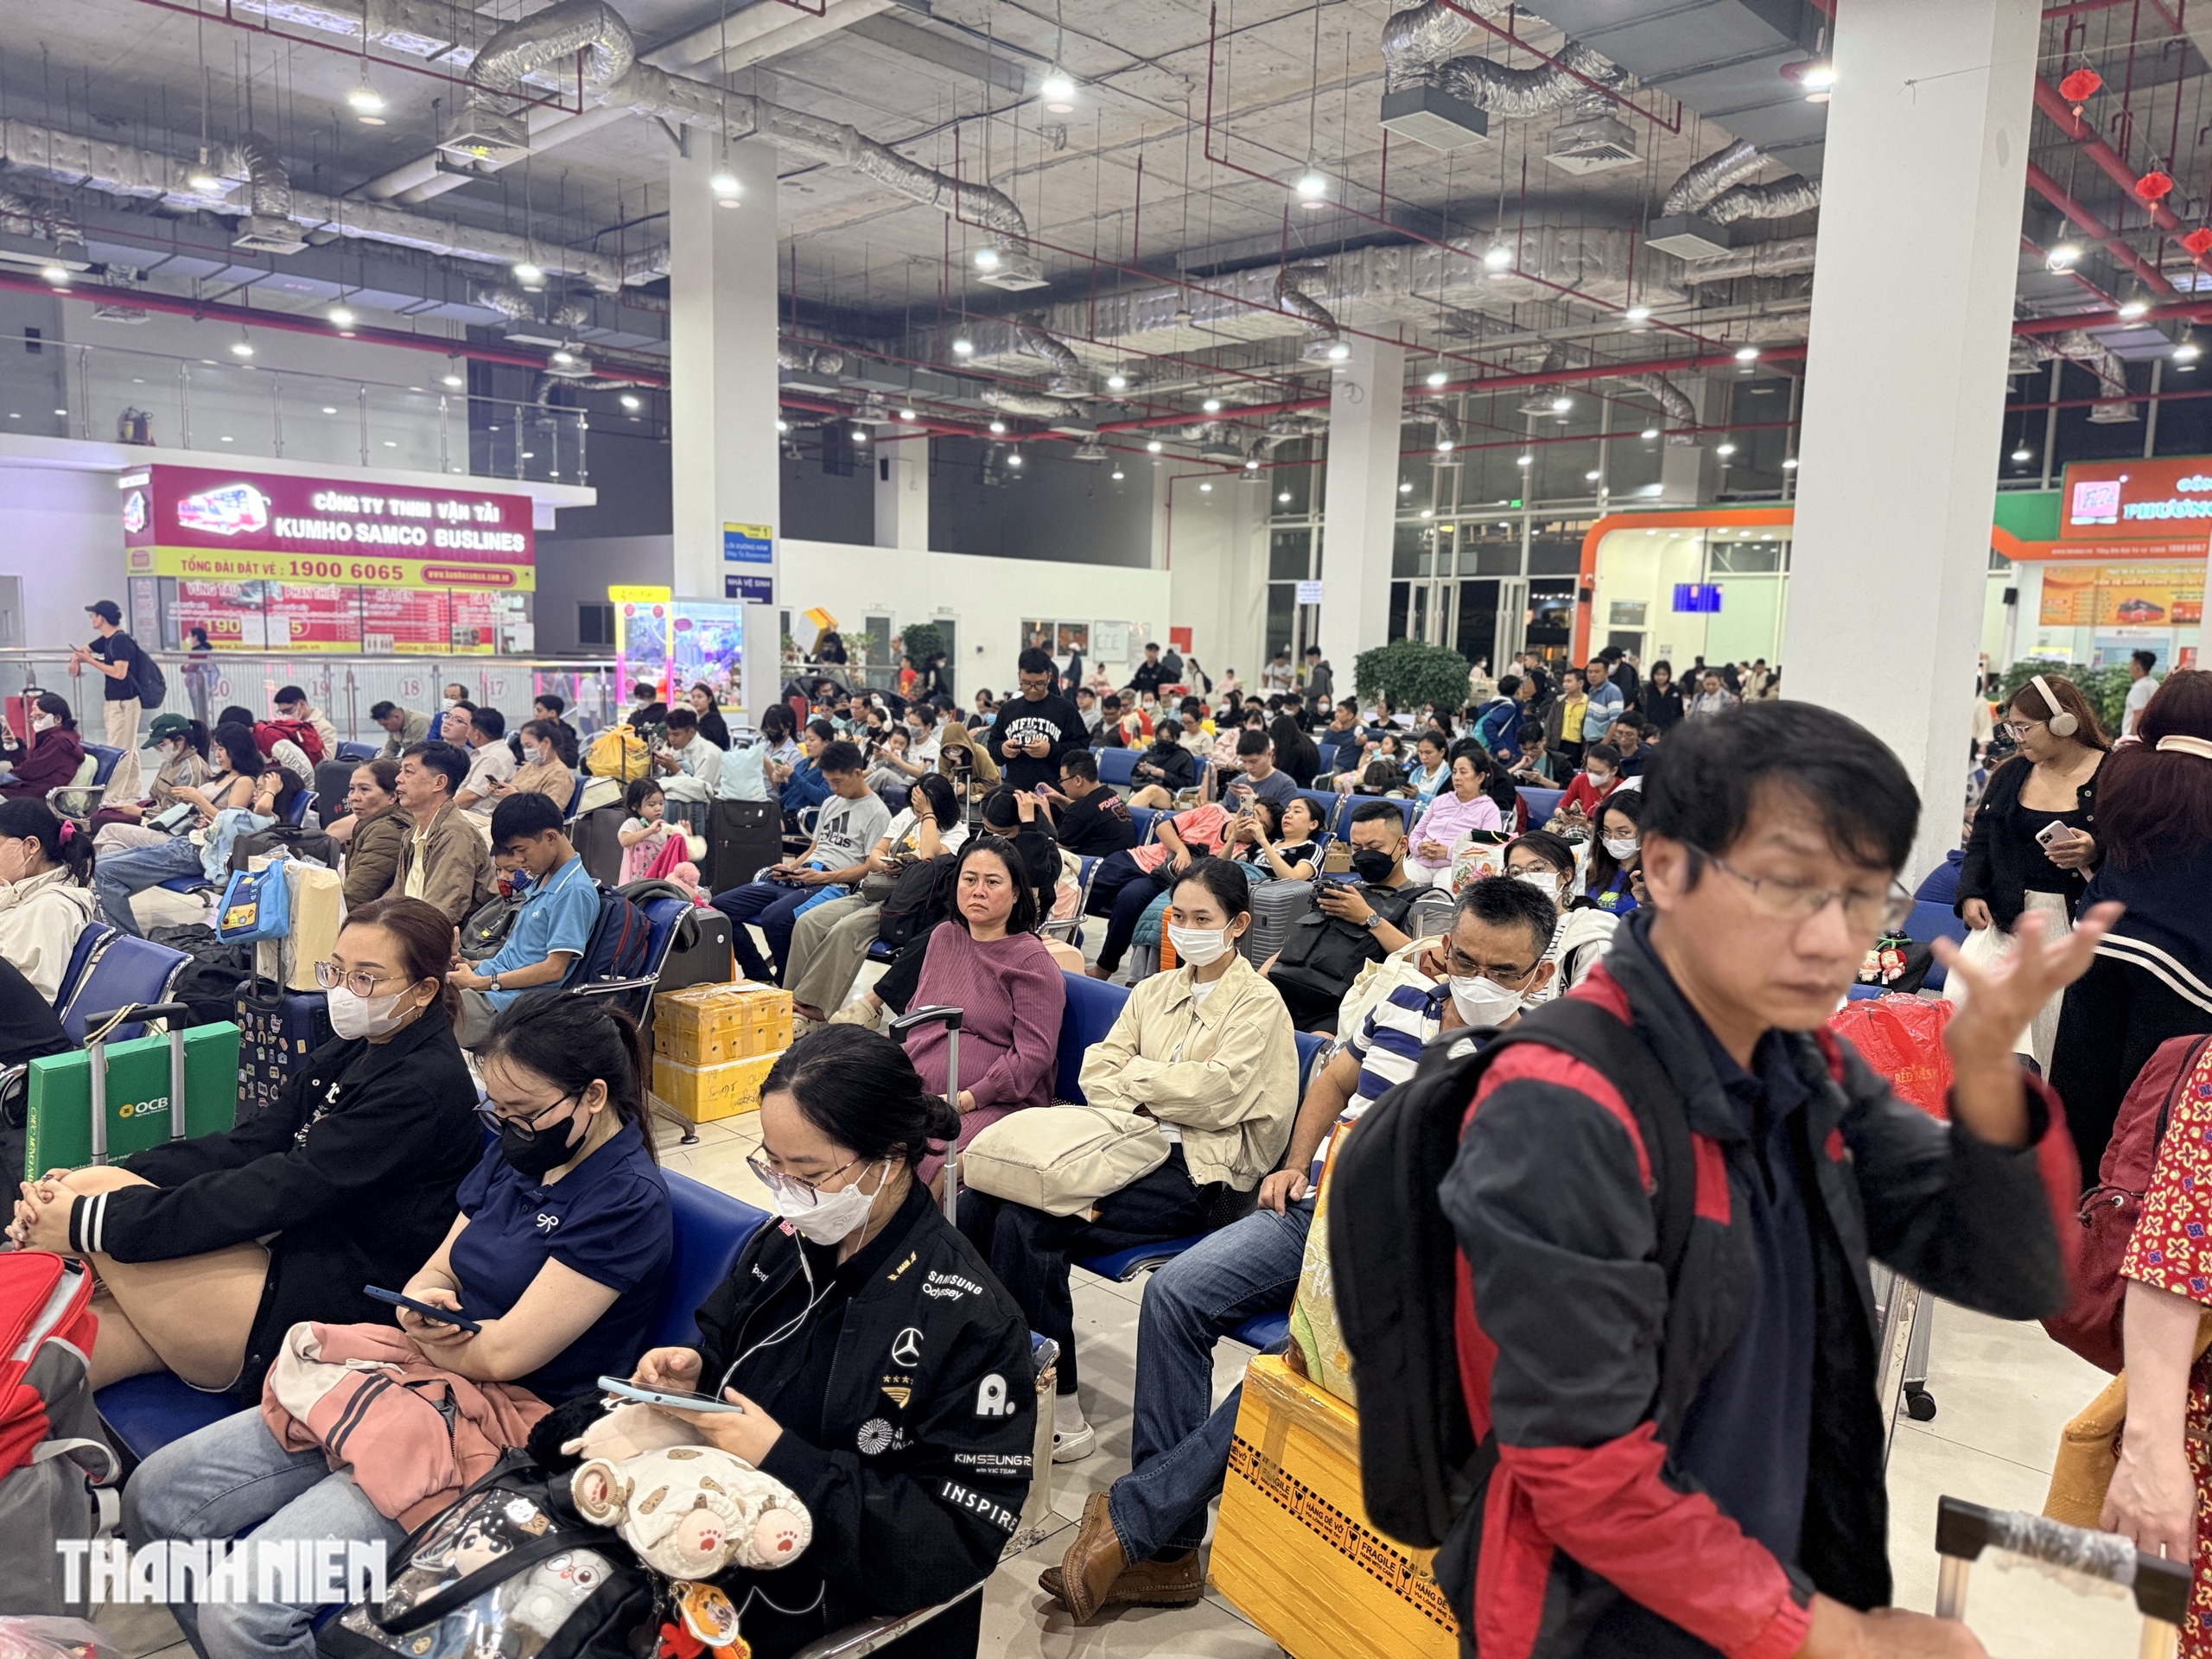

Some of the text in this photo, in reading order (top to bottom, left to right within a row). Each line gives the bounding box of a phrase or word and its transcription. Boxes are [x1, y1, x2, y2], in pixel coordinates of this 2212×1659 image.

[314, 491, 499, 524] CÔNG TY TNHH VẬN TẢI
[276, 517, 524, 552] KUMHO SAMCO BUSLINES
[289, 561, 341, 578] 1900
[351, 563, 403, 580] 6065
[312, 680, 330, 696] 19
[404, 680, 419, 696] 18
[490, 681, 504, 696] 17
[135, 1096, 168, 1113] OCB
[922, 1283, 963, 1300] Odyssey
[928, 1270, 983, 1294] SAMSUNG
[942, 1482, 1018, 1532] INSPIRE
[1361, 1541, 1396, 1573] FRAGILE
